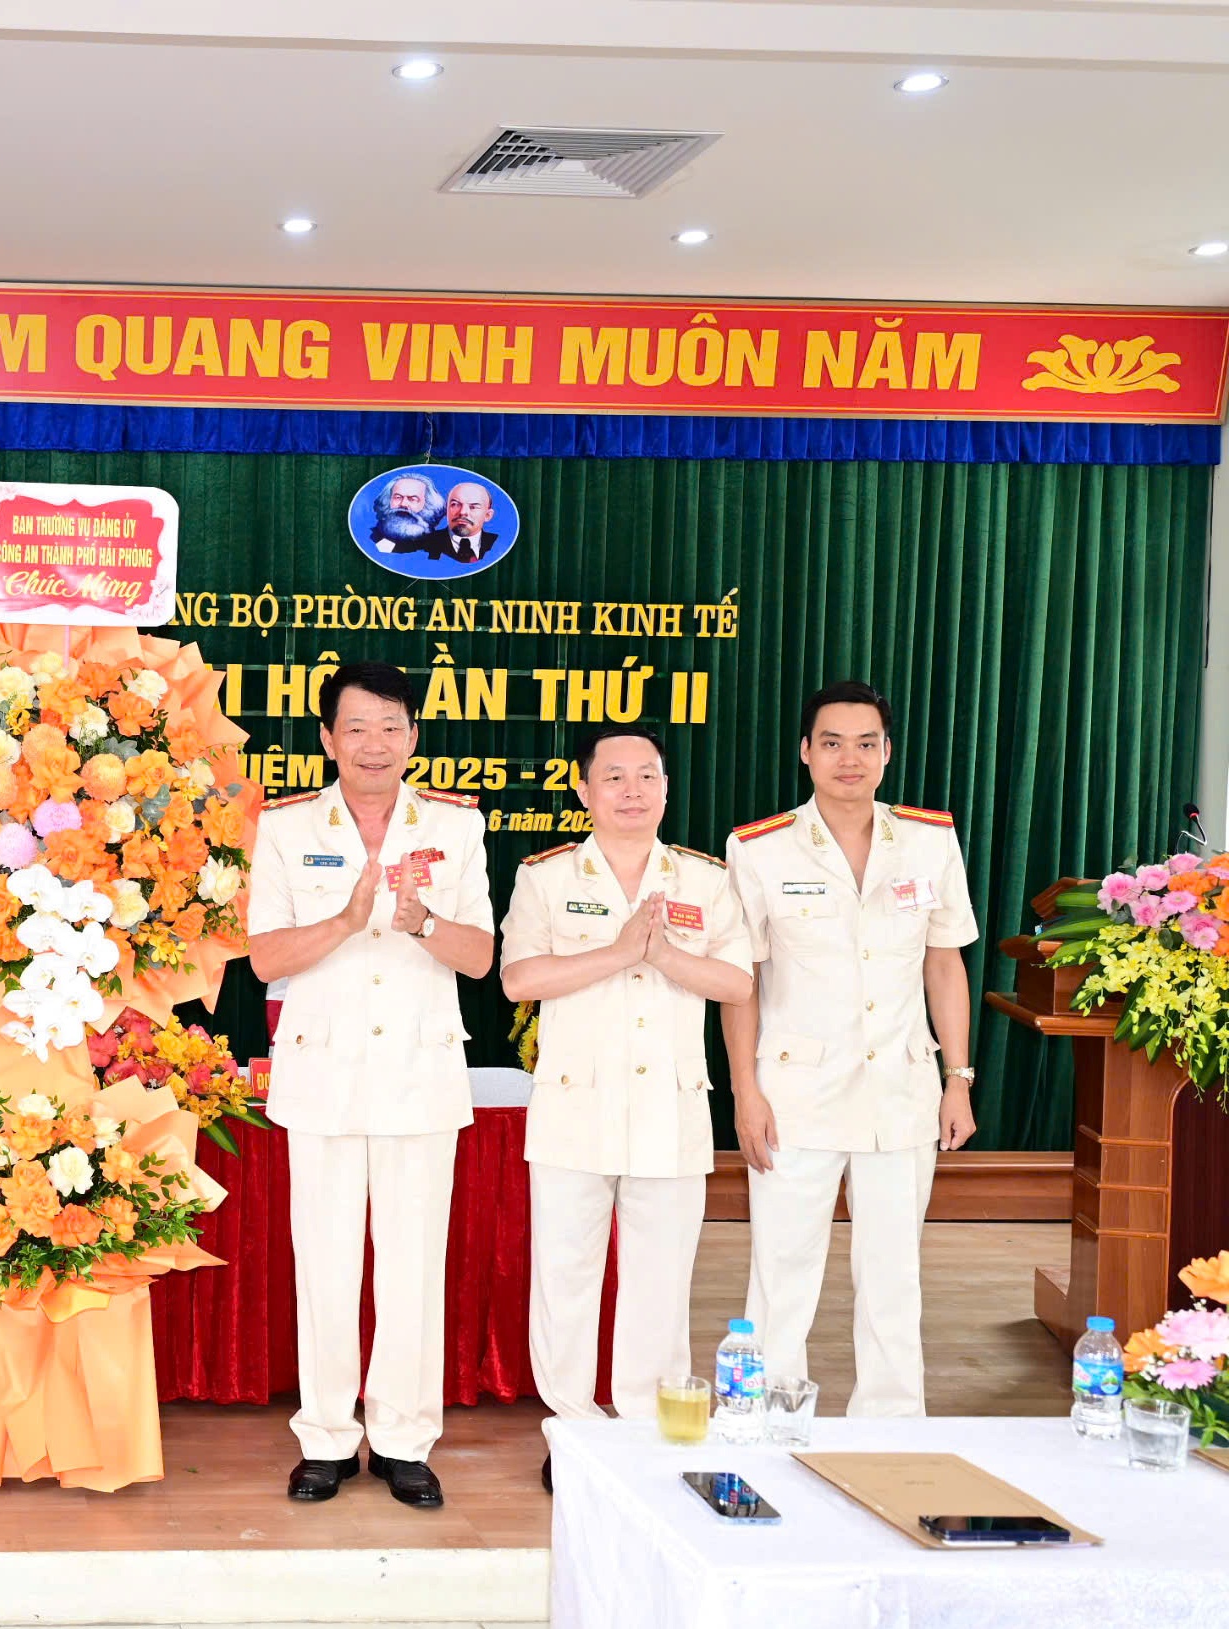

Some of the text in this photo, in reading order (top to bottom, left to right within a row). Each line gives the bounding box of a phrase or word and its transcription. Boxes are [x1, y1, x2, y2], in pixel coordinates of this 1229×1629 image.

[77, 315, 330, 381] QUANG
[364, 323, 533, 384] VINH
[560, 313, 779, 387] MUÔN
[804, 317, 981, 390] NĂM
[12, 515, 34, 535] BAN
[78, 517, 91, 541] VỤ
[93, 512, 120, 538] ĐẢNG
[24, 544, 39, 564] AN
[41, 542, 74, 566] THÀNH
[76, 542, 98, 567] PHỐ
[99, 541, 116, 567] HẢI
[118, 544, 153, 568] PHÒNG
[4, 569, 143, 606] Chúc Mừng
[168, 583, 739, 638] NG BỘ PHÒNG AN NINH KINH TẾ
[533, 656, 654, 724] THỨ
[670, 671, 709, 724] II
[405, 756, 507, 790] 2025
[488, 807, 596, 832] 6 năm 202
